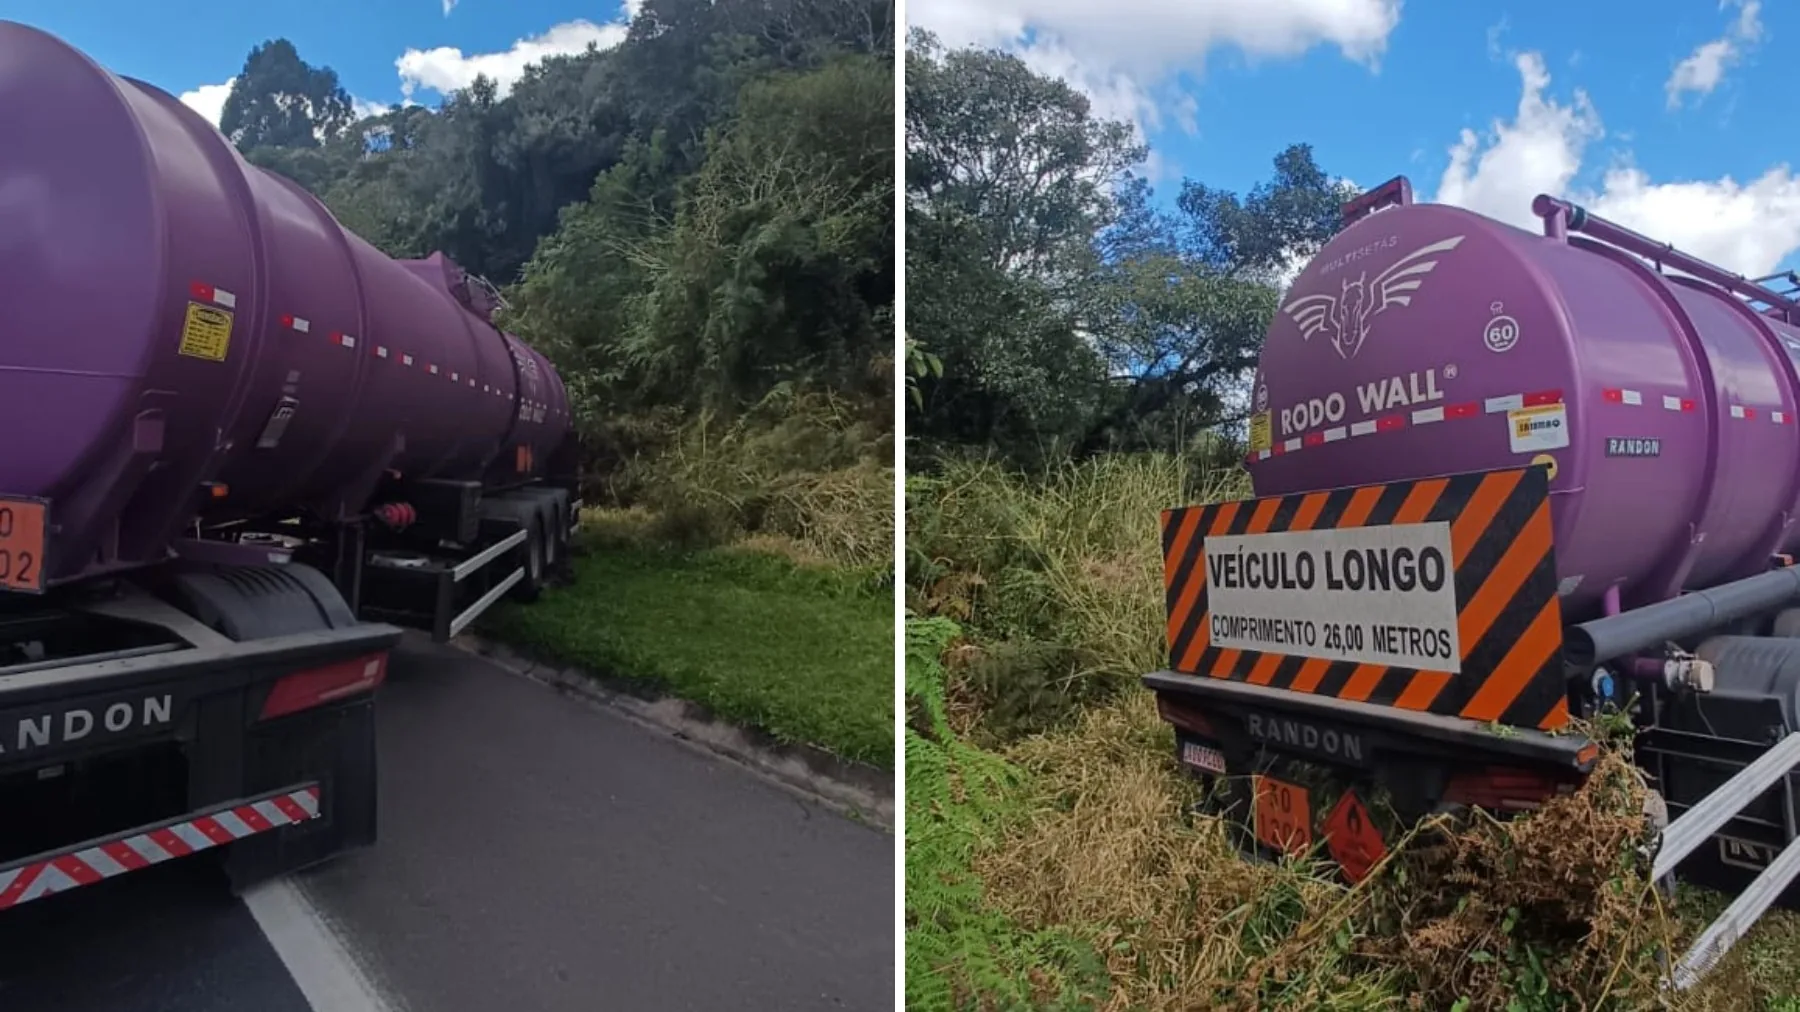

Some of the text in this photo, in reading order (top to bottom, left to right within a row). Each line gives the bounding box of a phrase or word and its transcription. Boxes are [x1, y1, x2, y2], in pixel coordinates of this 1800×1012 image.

[1489, 325, 1513, 341] 60
[1281, 392, 1346, 435] RODO
[1609, 438, 1660, 455] RANDON
[1208, 545, 1445, 592] VEÍCULO LONGO
[1212, 614, 1452, 660] COMPRIMENTO 26,00 METROS
[1248, 713, 1362, 760] RANDON
